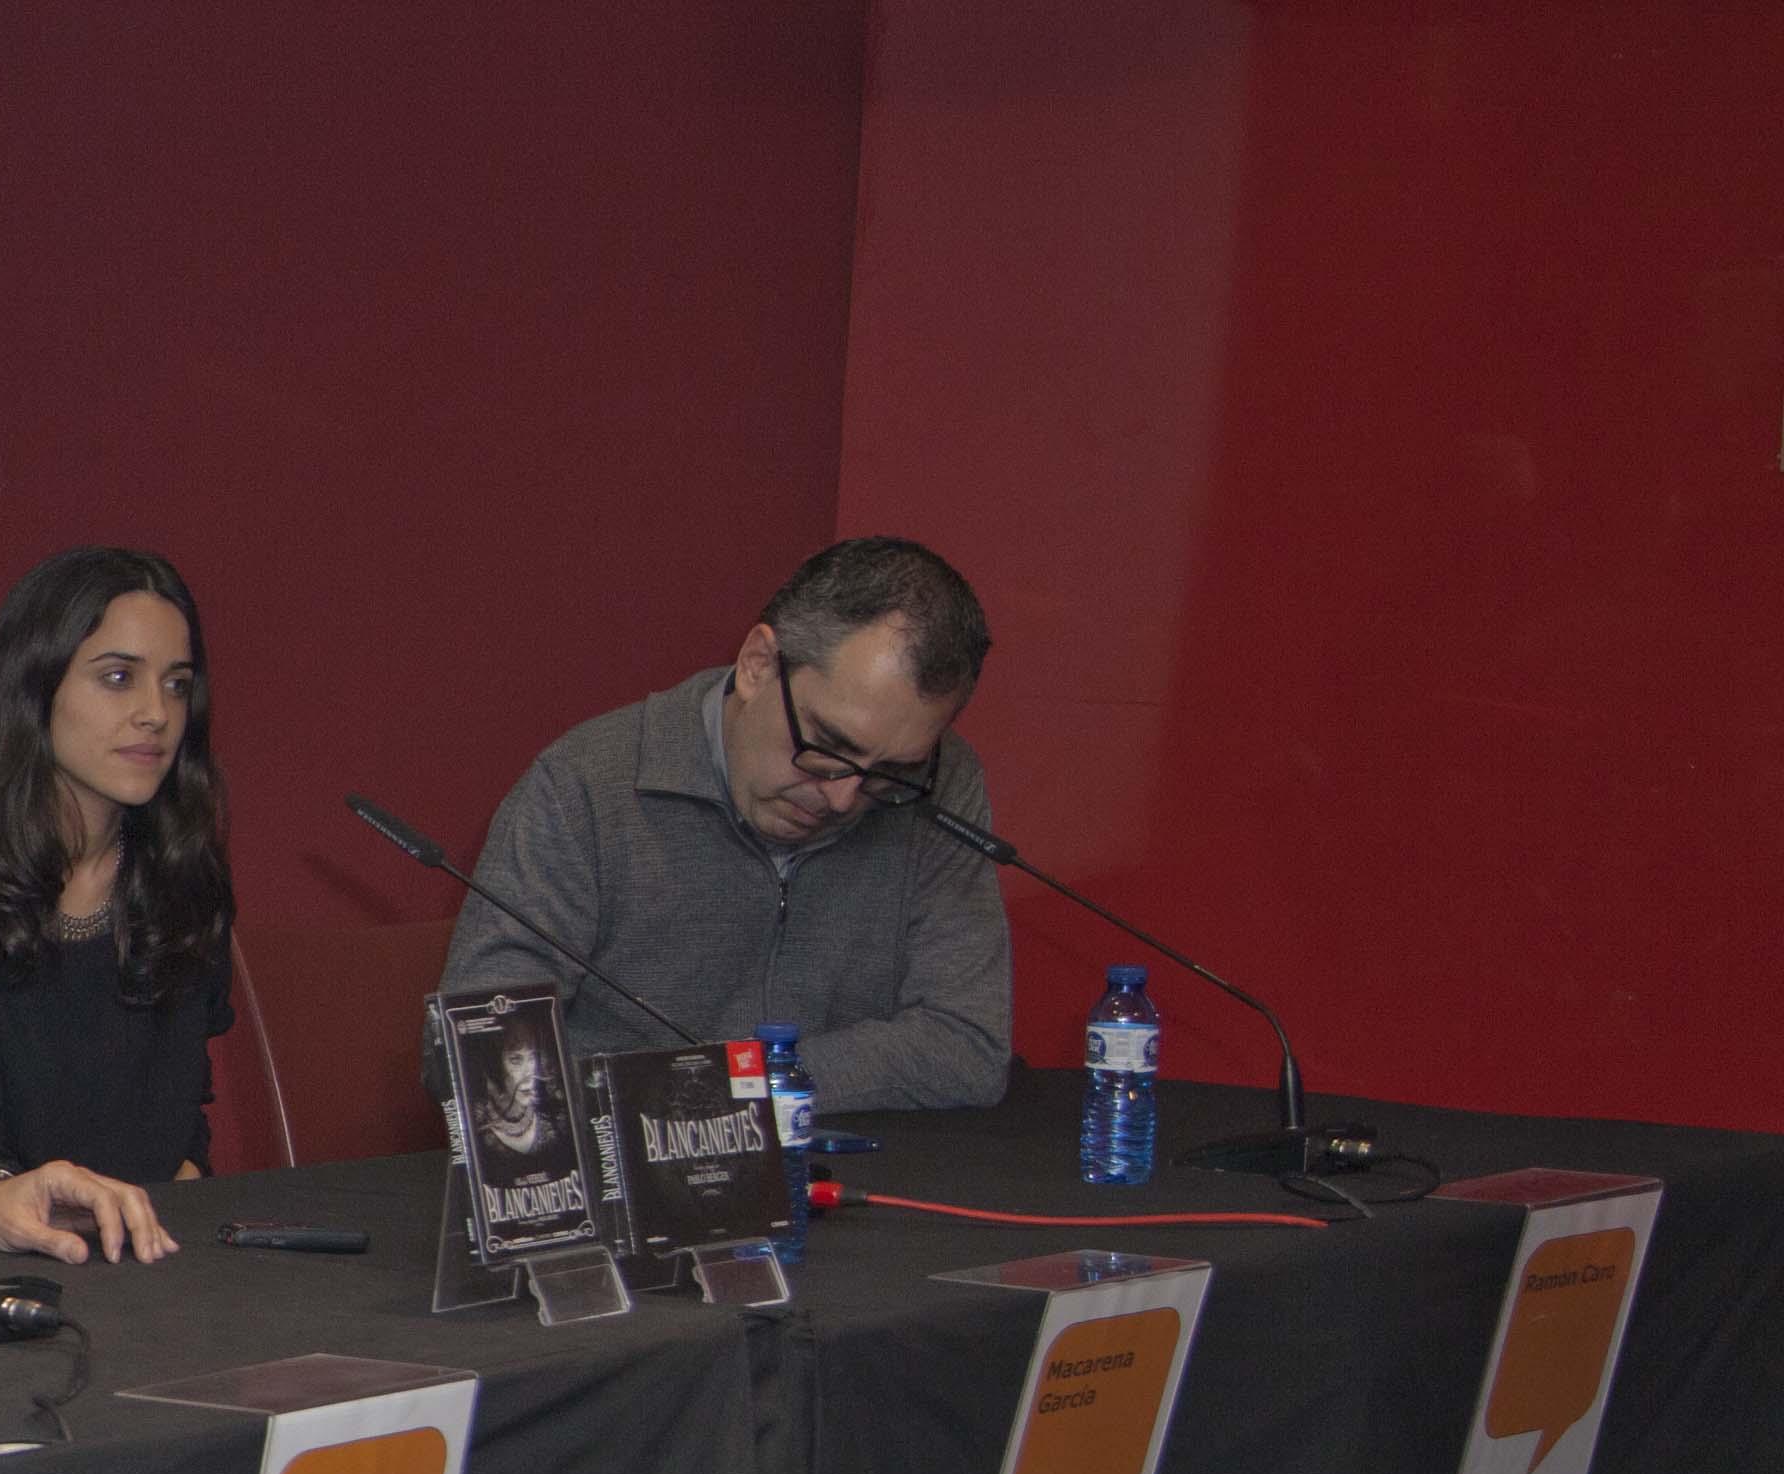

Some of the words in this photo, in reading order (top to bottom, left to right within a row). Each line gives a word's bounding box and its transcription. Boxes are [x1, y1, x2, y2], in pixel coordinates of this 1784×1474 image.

[590, 1114, 623, 1202] BLANCANIEVES
[639, 1101, 764, 1163] BLANCANIEVES
[482, 1169, 586, 1223] BLANCANIEVES
[1047, 1351, 1135, 1380] Macarena
[1039, 1384, 1097, 1414] García
